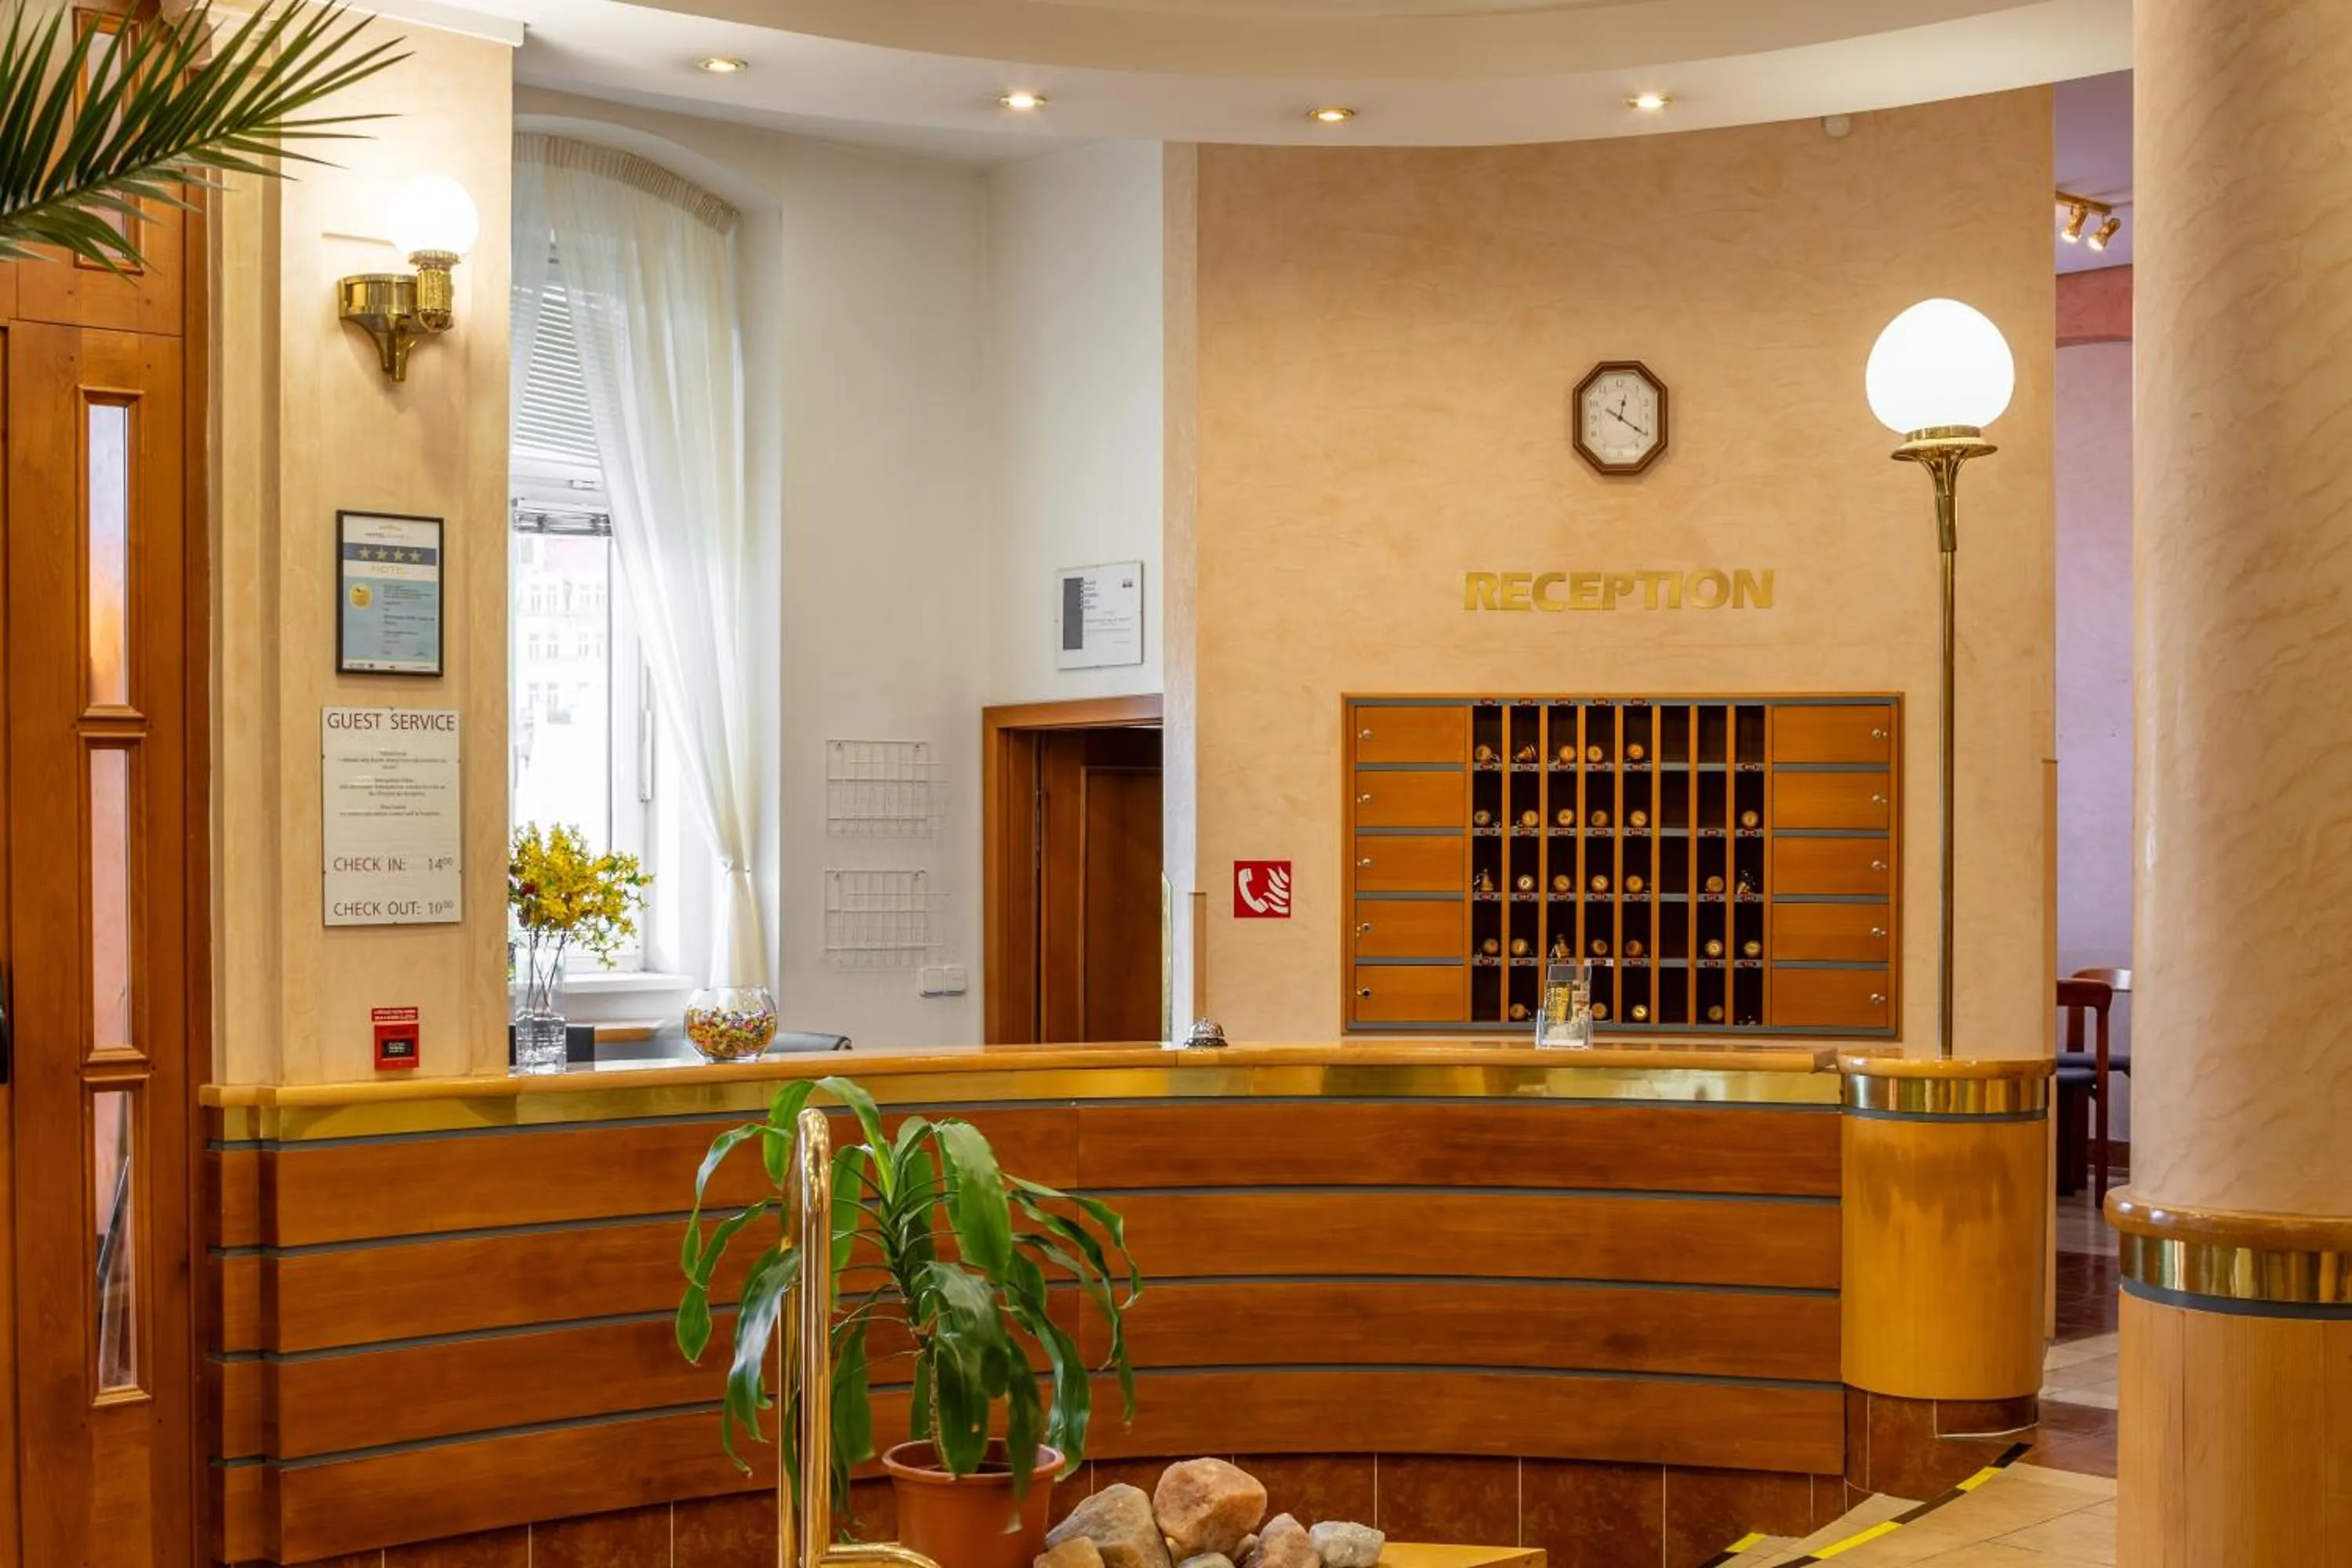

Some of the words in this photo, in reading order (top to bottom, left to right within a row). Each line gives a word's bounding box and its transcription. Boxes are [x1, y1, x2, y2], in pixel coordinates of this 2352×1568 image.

[1464, 568, 1775, 612] RECEPTION
[327, 713, 383, 730] GUEST
[390, 713, 456, 731] SERVICE
[333, 856, 381, 872] CHECK
[388, 858, 407, 873] IN:
[333, 901, 381, 916] CHECK
[388, 901, 421, 916] OUT:
